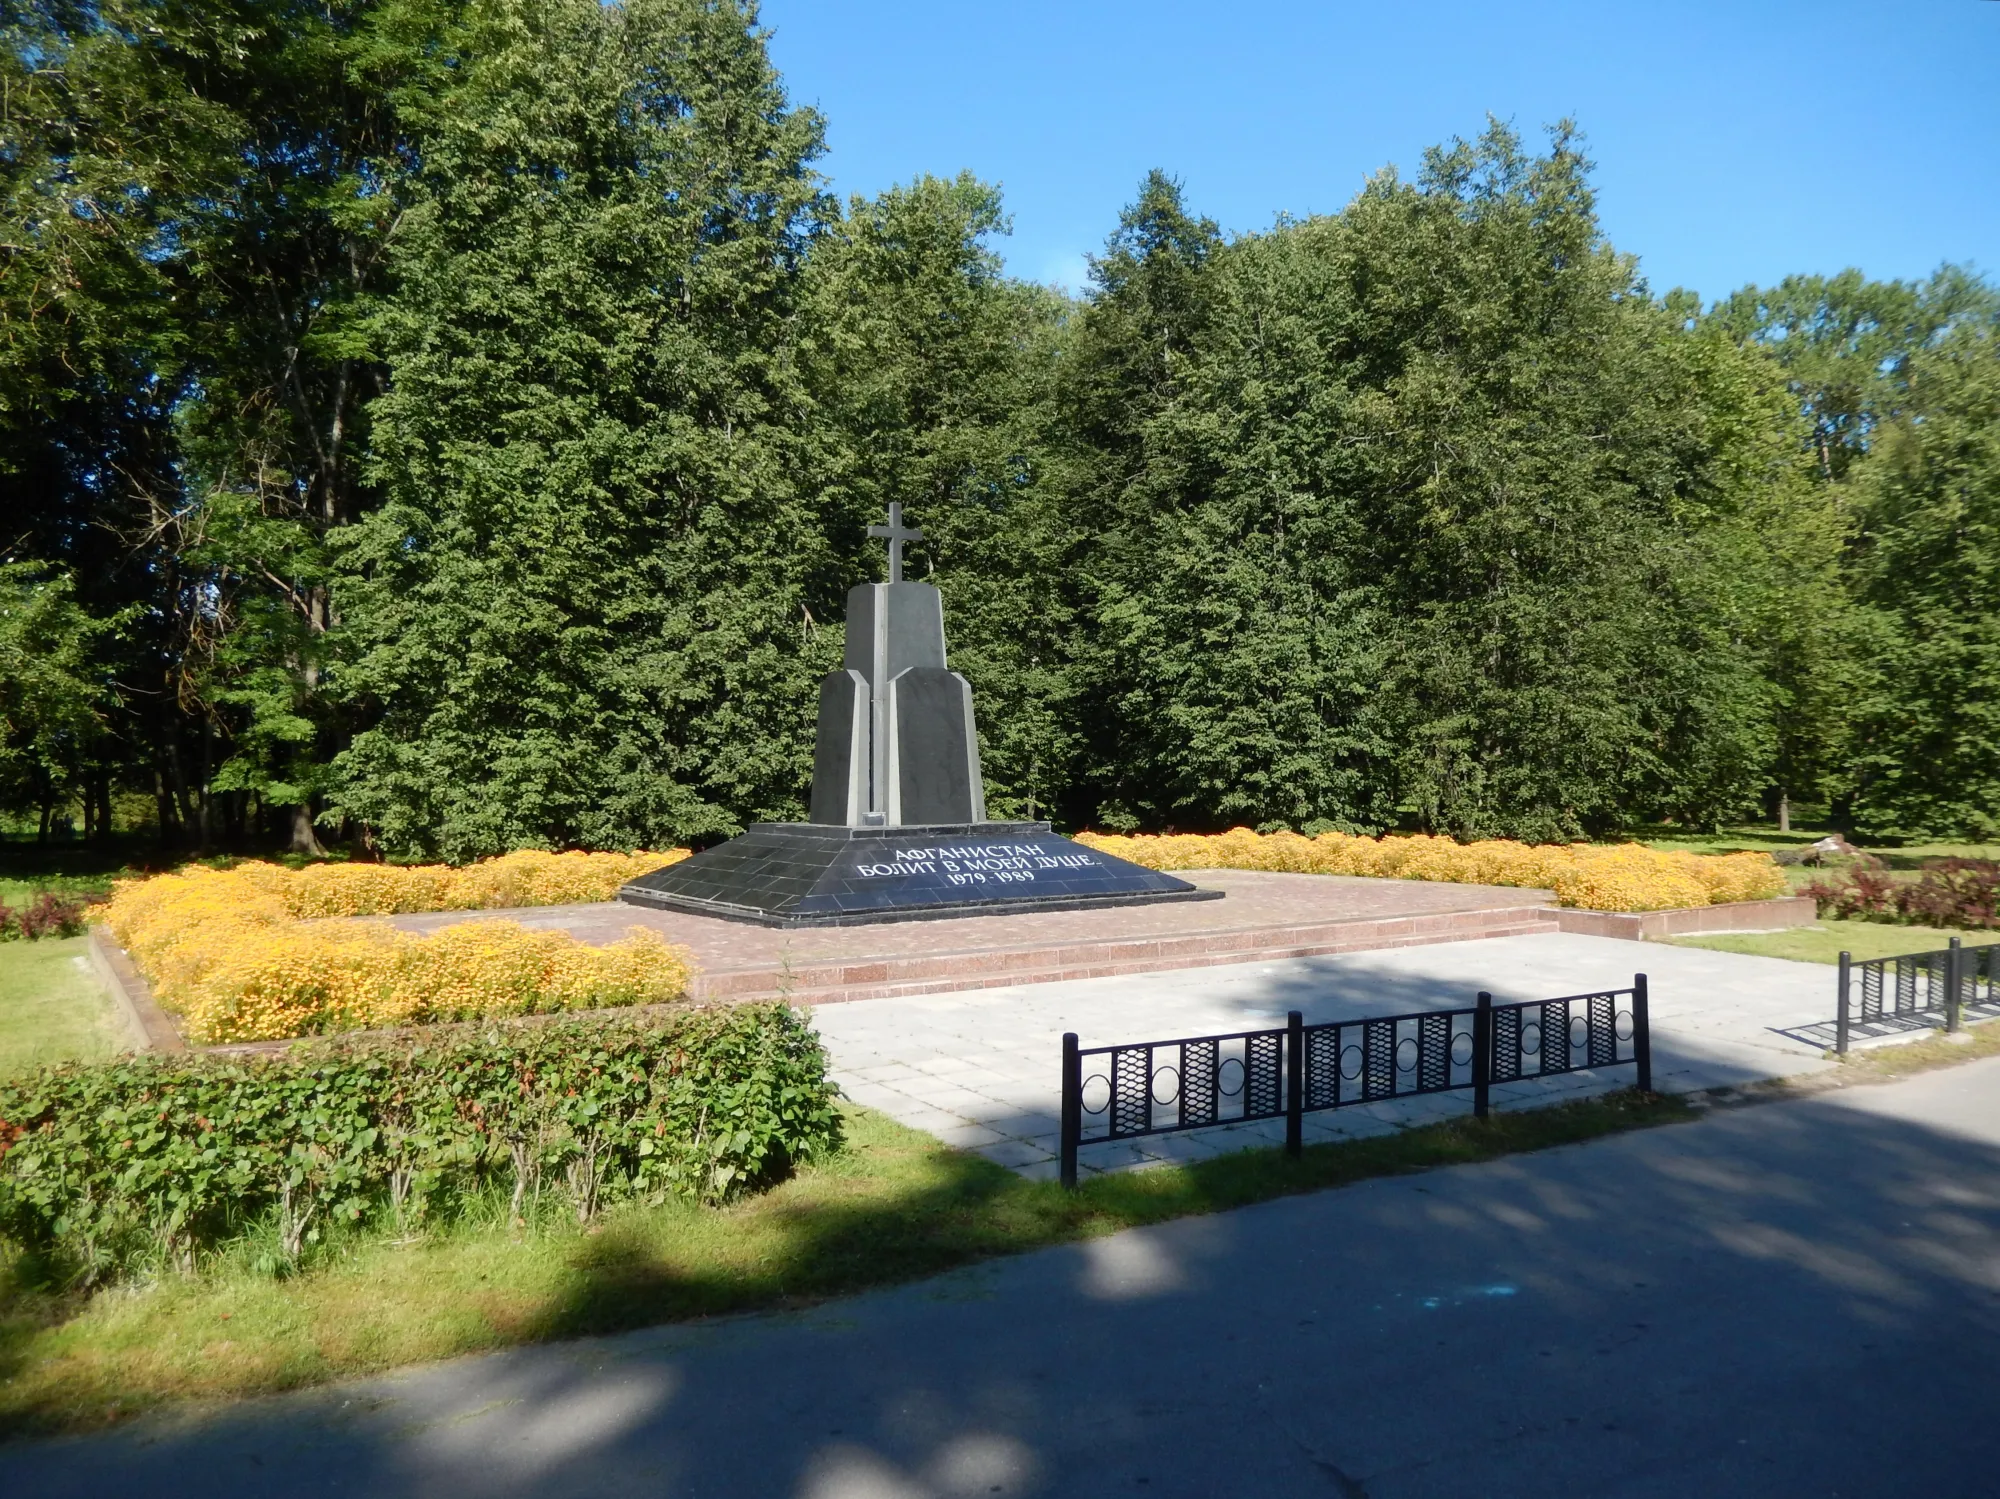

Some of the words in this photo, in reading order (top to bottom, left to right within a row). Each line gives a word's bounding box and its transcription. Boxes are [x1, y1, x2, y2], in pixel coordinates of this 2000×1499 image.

[896, 844, 1046, 861] АФГАНИСТАН
[857, 861, 937, 877] БОЛИТ
[942, 860, 961, 872] В
[963, 856, 1033, 871] МОЕЙ
